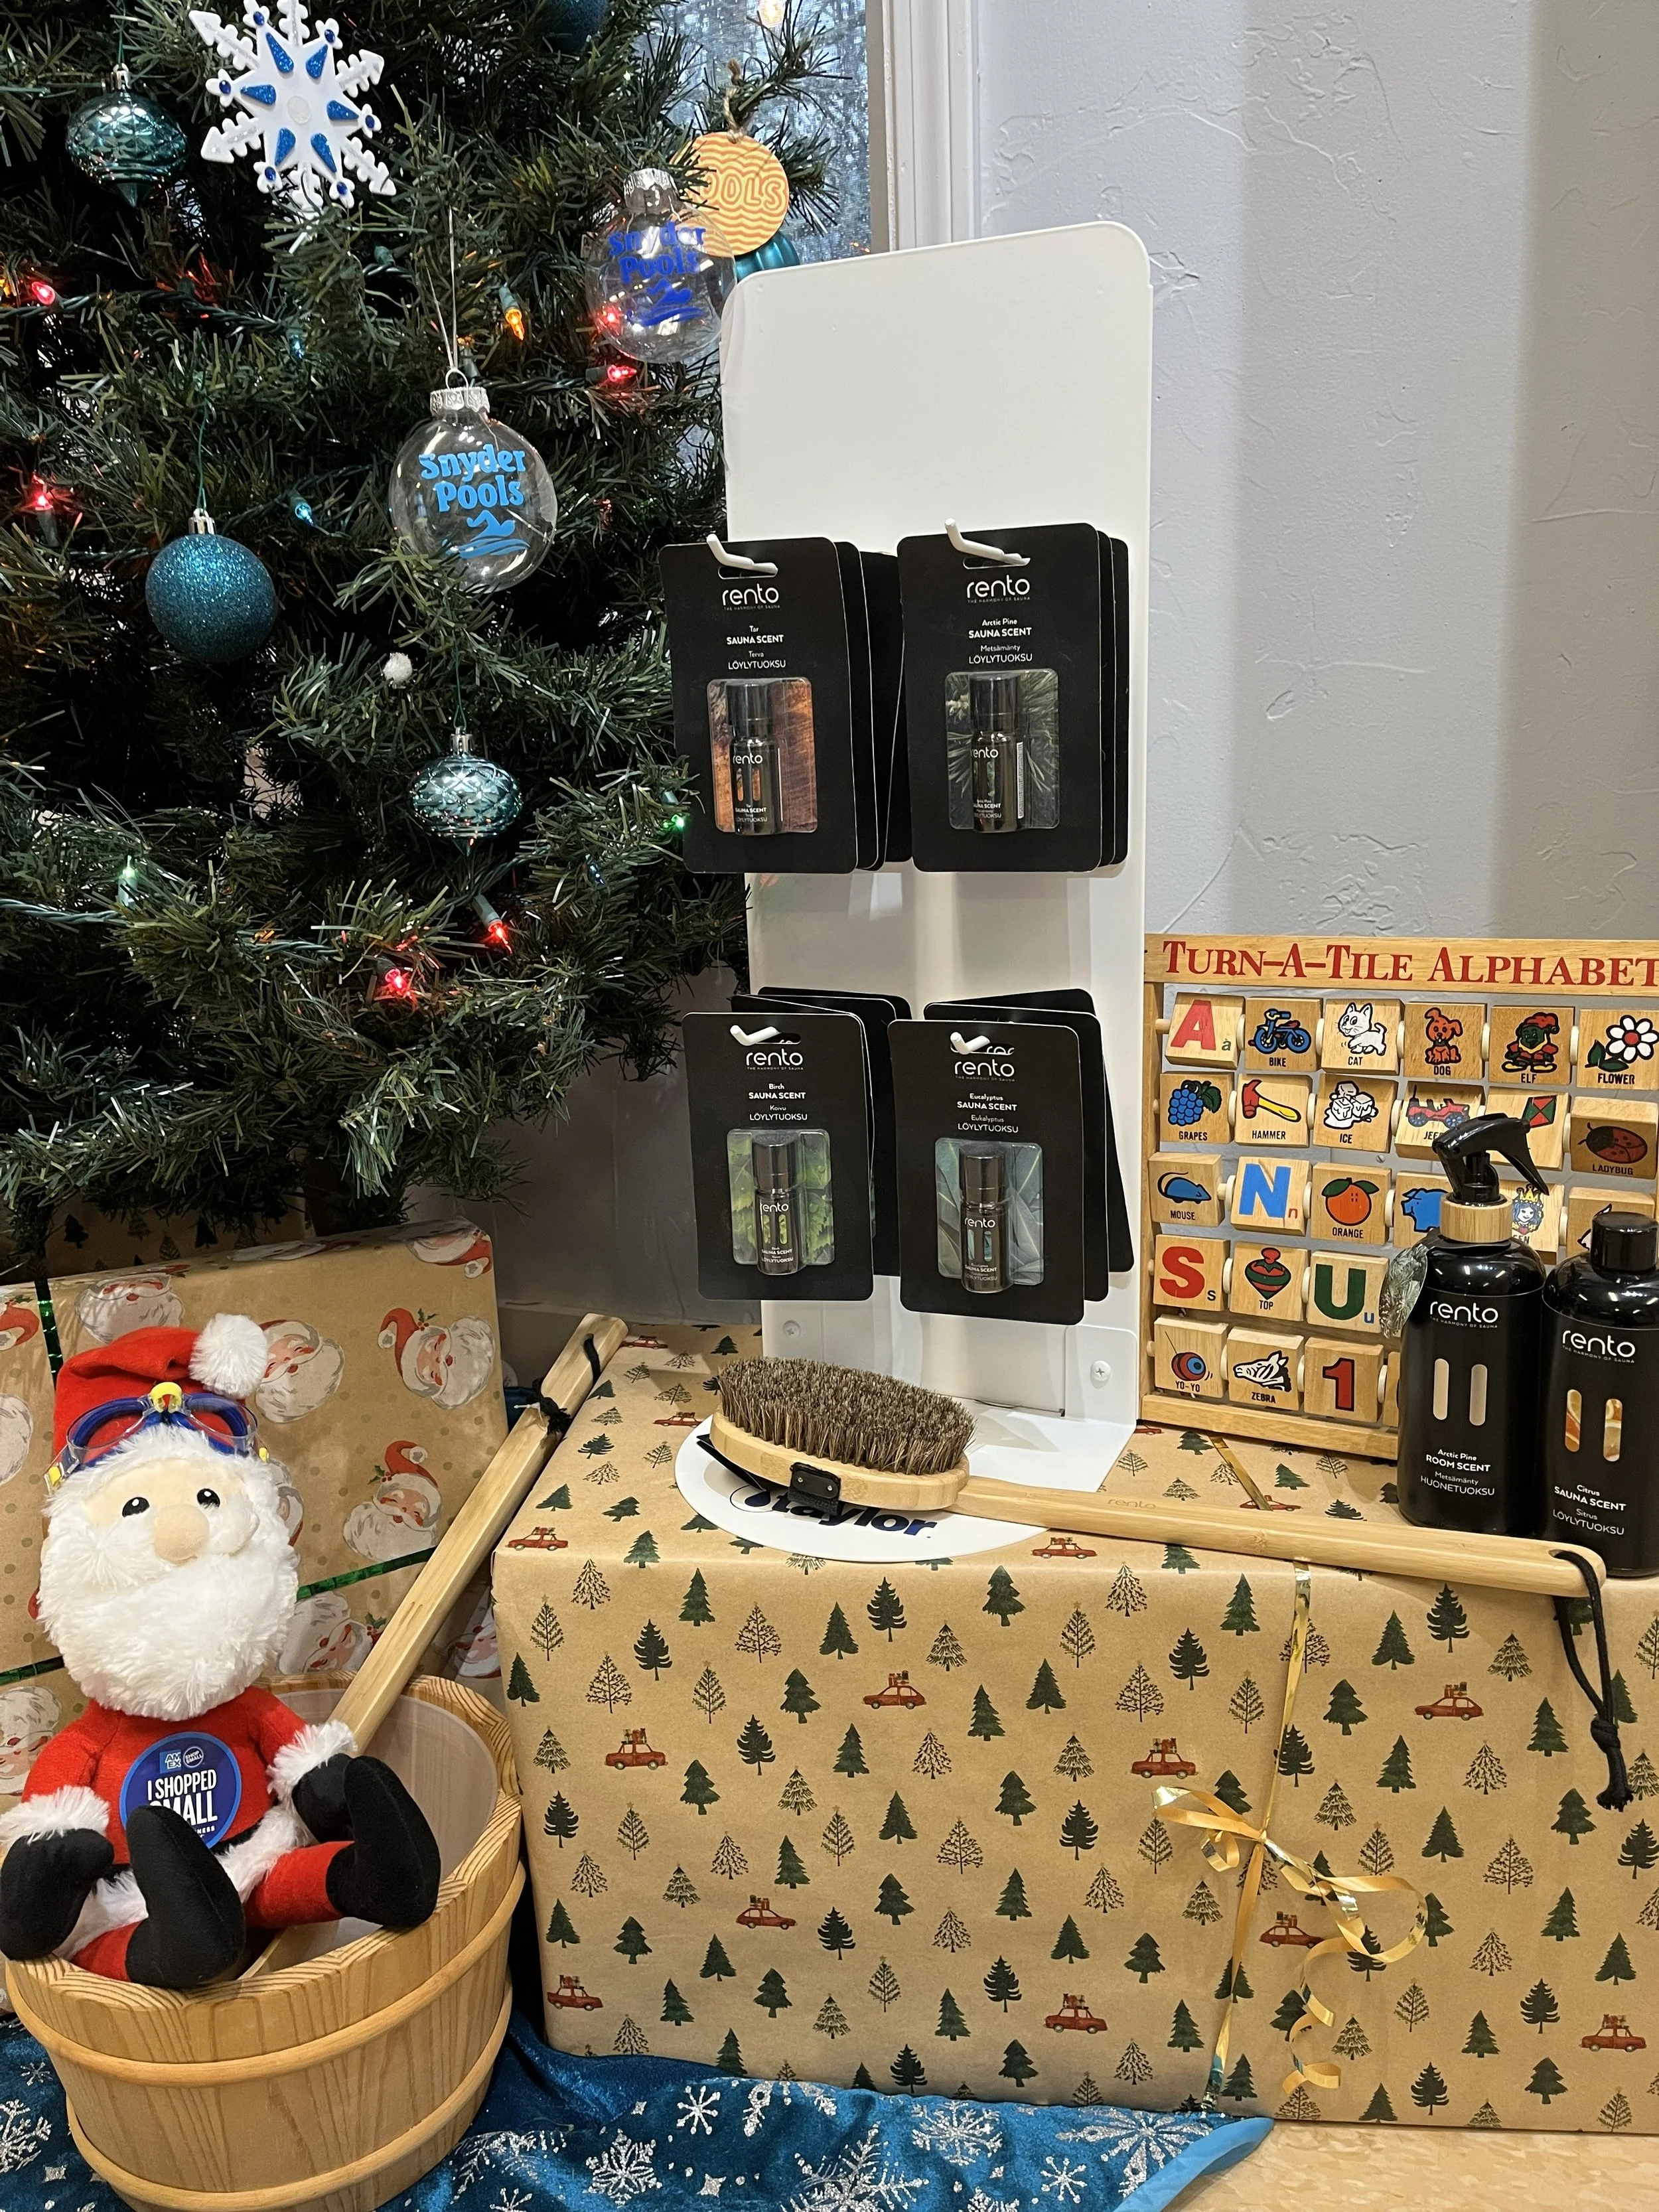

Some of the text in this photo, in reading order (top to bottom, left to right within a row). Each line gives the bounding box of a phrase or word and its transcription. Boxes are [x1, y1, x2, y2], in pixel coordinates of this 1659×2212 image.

[618, 245, 700, 284] Pools
[419, 443, 526, 482] Snyder
[434, 475, 524, 512] Pools
[967, 574, 1030, 599] rento
[722, 583, 779, 606] rento
[969, 627, 1032, 638] SAUNA SCENT
[727, 634, 784, 645] SAUNA SCENT
[969, 653, 1033, 664] LÖYLYTUOKSU
[728, 660, 786, 670] LÖYLYTUOKSU
[1163, 940, 1659, 987] TURN-A-TILE ALPHABET
[1171, 999, 1216, 1051] A
[746, 1048, 803, 1066] rento
[1269, 1057, 1287, 1067] BIKE
[1348, 1057, 1363, 1067] CAT
[954, 1059, 1015, 1077] rento
[1433, 1066, 1451, 1076] DOG
[1521, 1073, 1537, 1084] ELF
[1598, 1072, 1635, 1085] FLOWER
[957, 1101, 1017, 1112] SAUNA SCENT
[971, 1114, 1005, 1123] Eukalyptus
[958, 1122, 1019, 1133] LÖYLYTUOKSU
[1179, 1131, 1208, 1141] GRAPES
[1252, 1130, 1286, 1140] HAMMER
[1339, 1134, 1353, 1144] ICE
[1593, 1163, 1633, 1175] LADYBUG
[1239, 1163, 1298, 1218] N n
[1170, 1210, 1196, 1220] MOUSE
[964, 1217, 995, 1228] rento
[1332, 1227, 1364, 1239] ORANGE
[1160, 1246, 1204, 1299] S
[1314, 1264, 1366, 1321] U
[1260, 1299, 1273, 1310] TOP
[1430, 1301, 1498, 1323] rento
[1562, 1330, 1636, 1358] rento
[1573, 1349, 1601, 1359] HARMONY
[1175, 1380, 1200, 1392] YO-YO
[1323, 1357, 1355, 1412] 1
[1251, 1391, 1276, 1404] ZEBRA
[1437, 1449, 1459, 1459] Arctic
[1426, 1454, 1490, 1472] ROOM SCENT
[1435, 1471, 1479, 1486] Metsämänty
[1420, 1475, 1495, 1496] HUONETUOKSU
[1577, 1485, 1600, 1497] Citrus
[1107, 1499, 1156, 1509] rento
[1554, 1486, 1626, 1511] SAUNA SCENT
[1576, 1508, 1598, 1520] Sitrus
[147, 1769, 216, 1801] I SHOPPED
[149, 1791, 218, 1826] MALL
